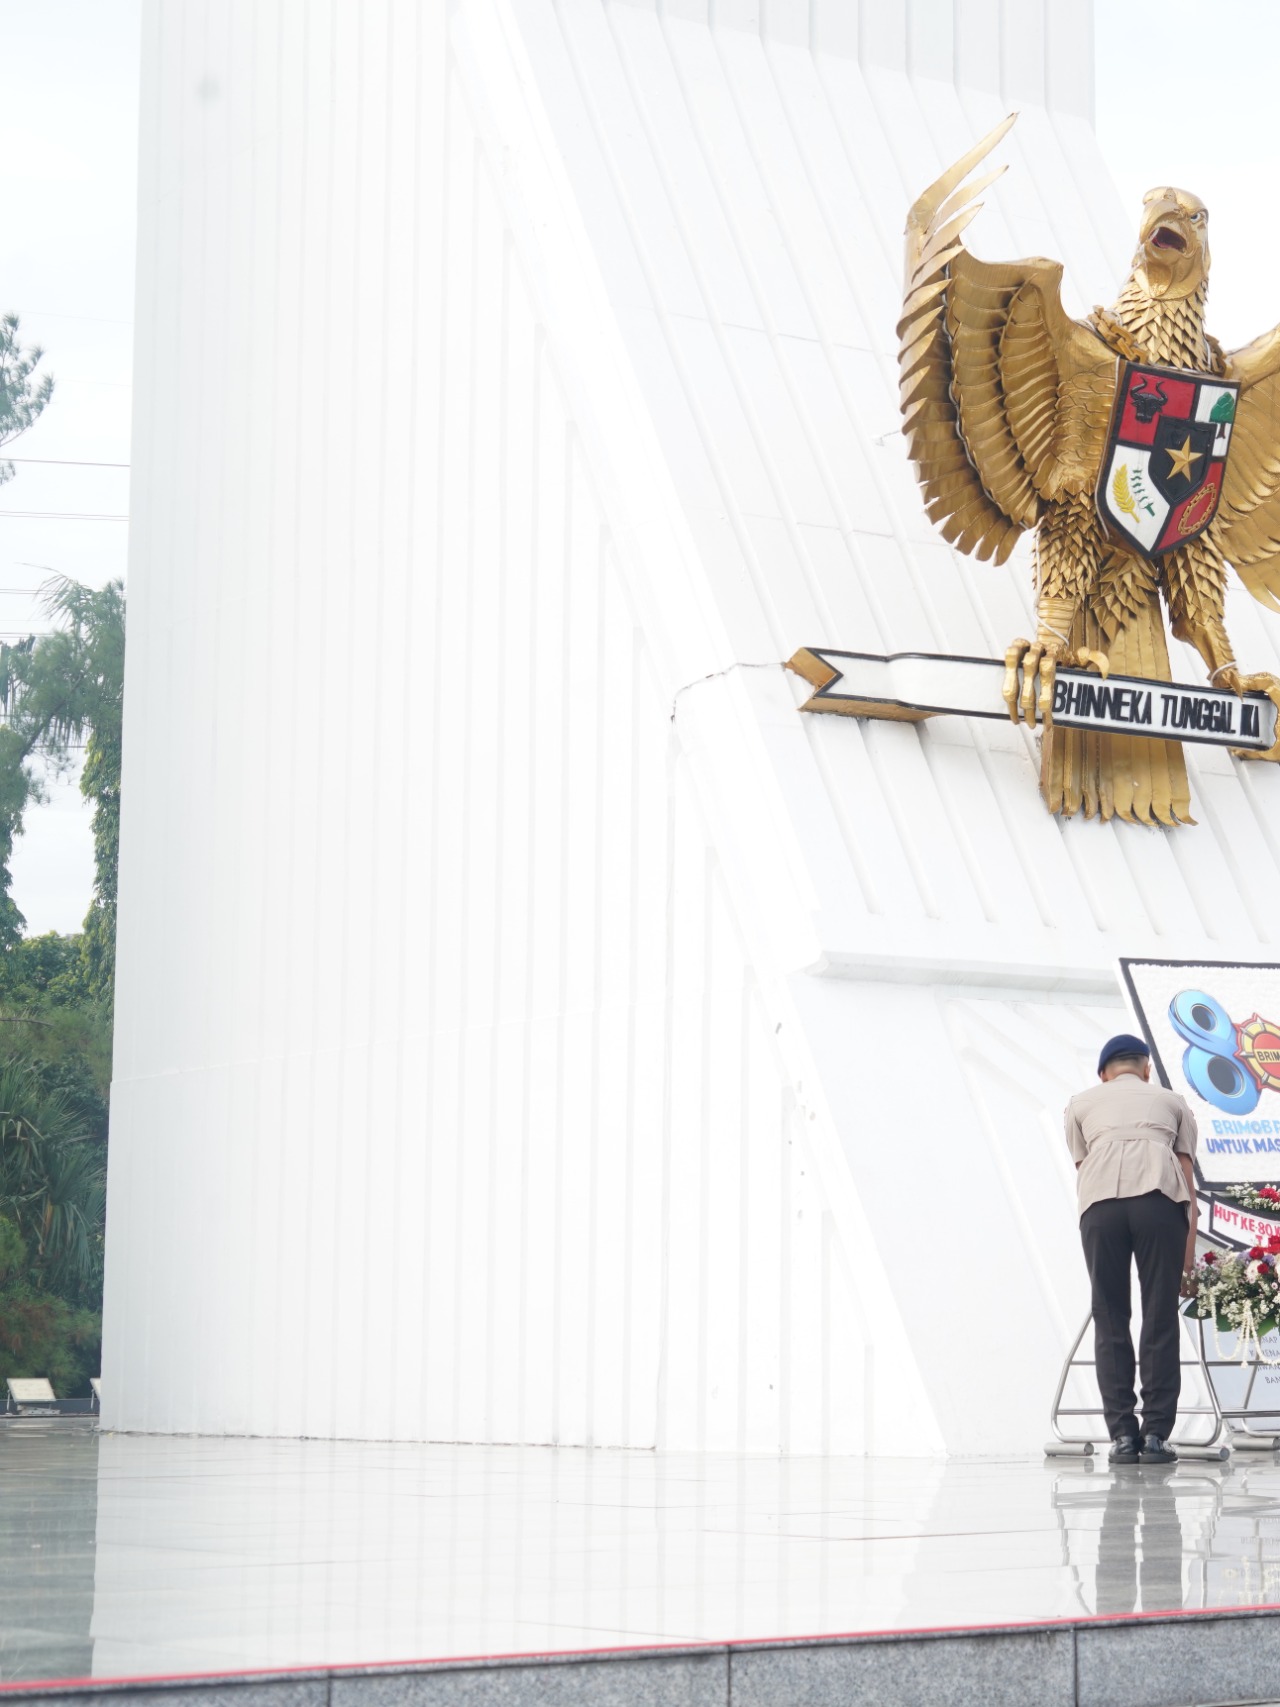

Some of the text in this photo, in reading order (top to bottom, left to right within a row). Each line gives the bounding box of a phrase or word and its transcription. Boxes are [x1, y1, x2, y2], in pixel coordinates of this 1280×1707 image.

[1051, 679, 1153, 725] BHINNEKA
[1160, 693, 1236, 734] TUNGGAL
[1211, 1119, 1273, 1135] BRIMOB
[1205, 1138, 1253, 1154] UNTUK
[1213, 1204, 1239, 1226] HUT
[1240, 1216, 1273, 1237] KE-80
